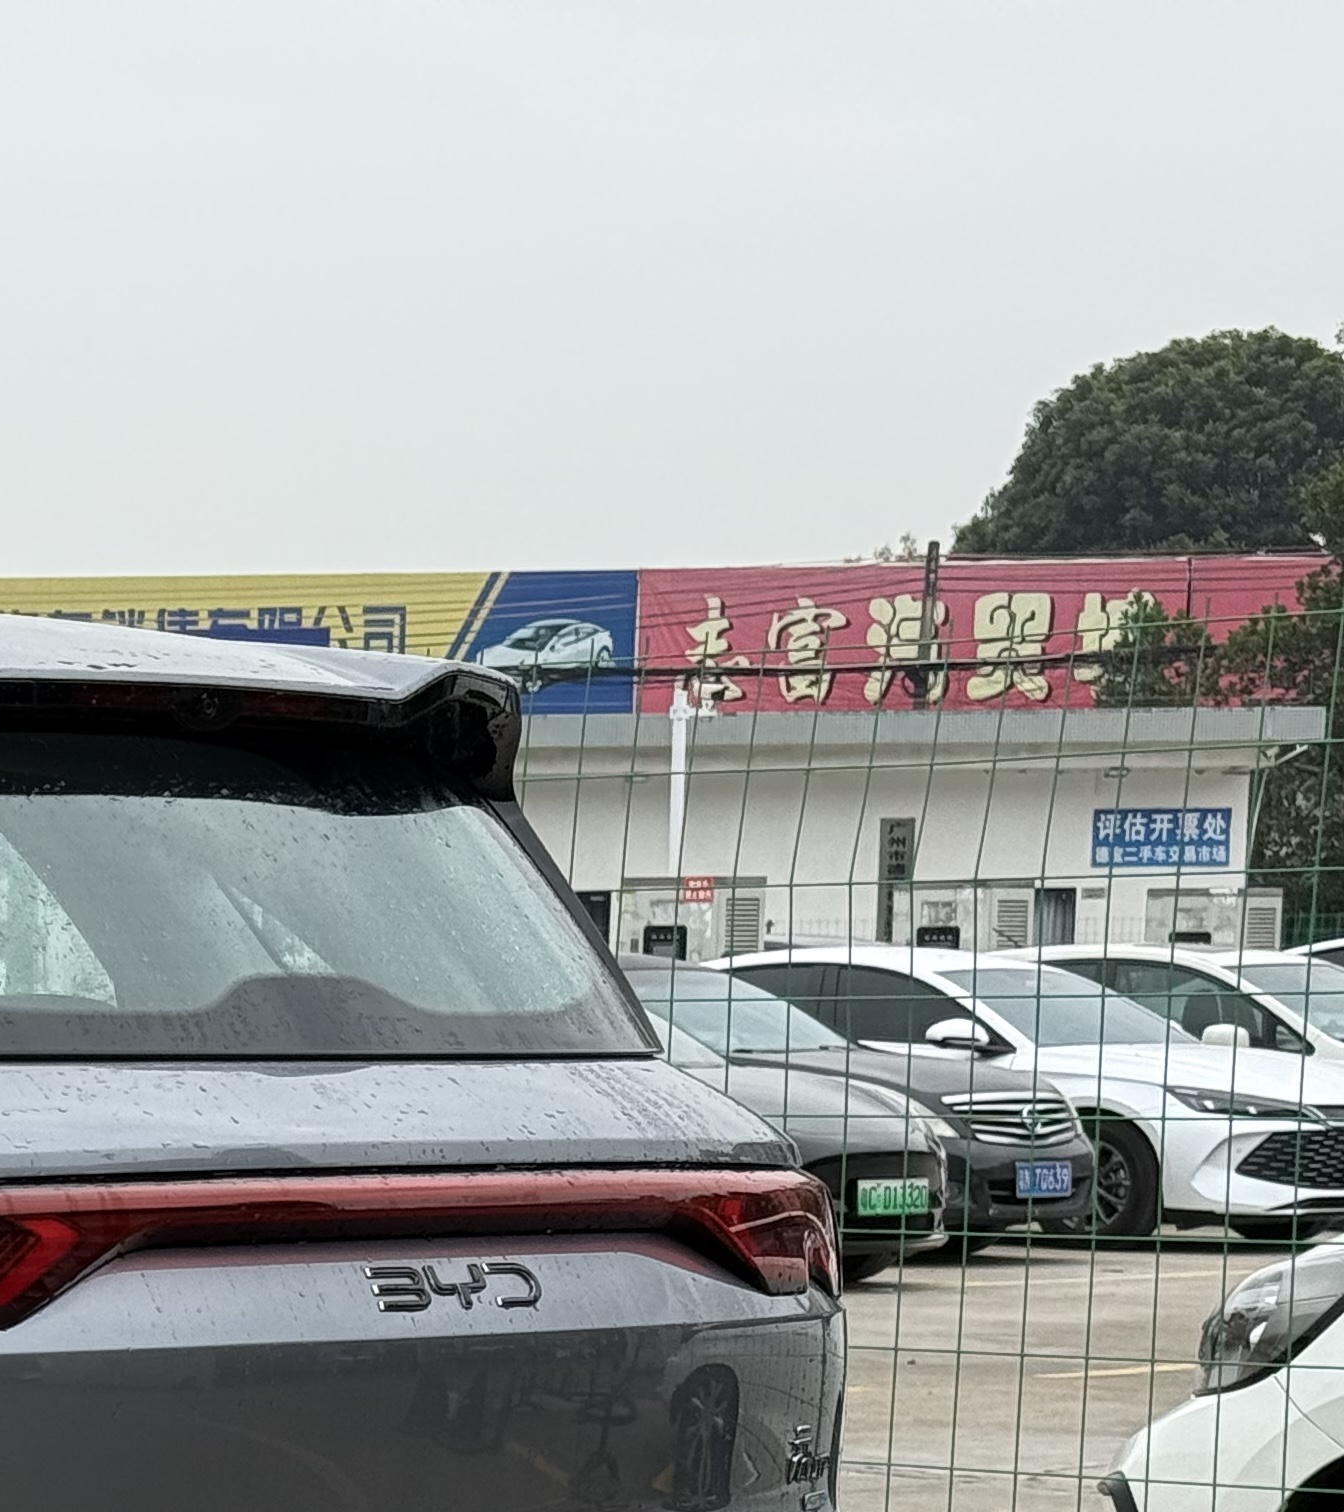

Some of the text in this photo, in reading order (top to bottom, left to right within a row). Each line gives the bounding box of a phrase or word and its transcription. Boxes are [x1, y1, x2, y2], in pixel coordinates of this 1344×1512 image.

[1096, 811, 1227, 843] 评估开票处
[363, 1262, 542, 1312] BYD
